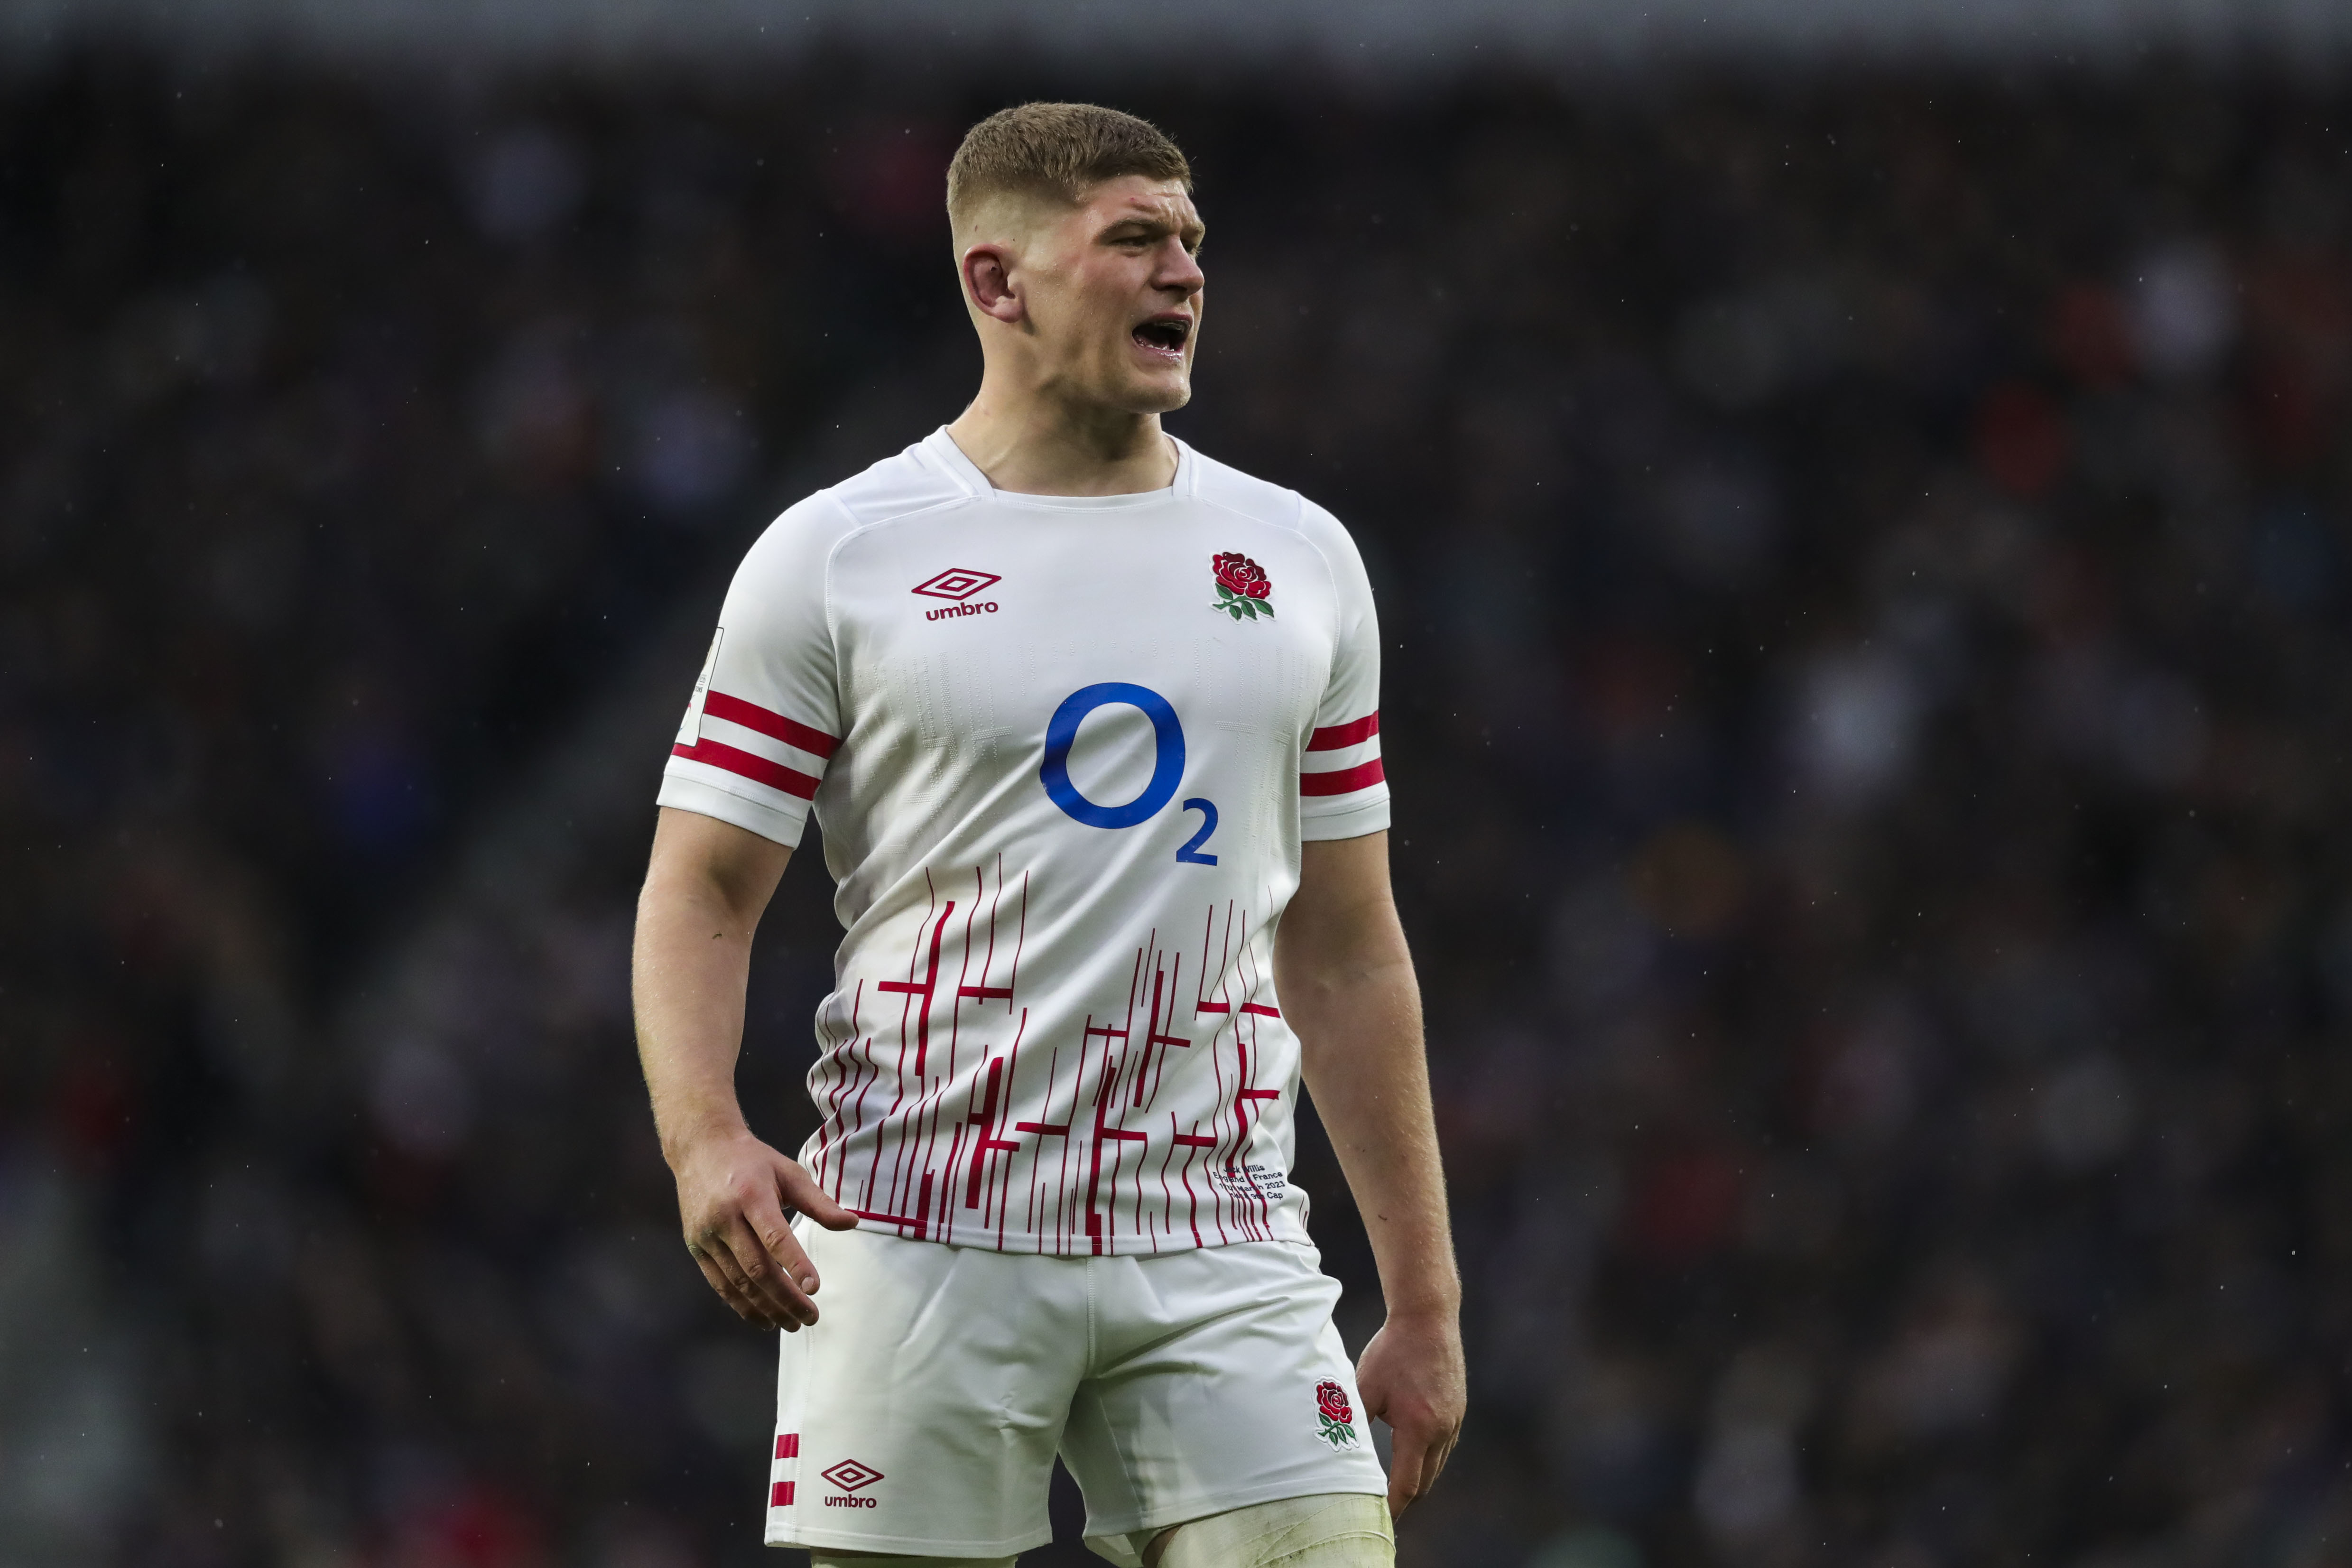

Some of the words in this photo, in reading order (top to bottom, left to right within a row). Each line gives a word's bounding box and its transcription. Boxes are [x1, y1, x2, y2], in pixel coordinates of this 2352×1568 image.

[926, 602, 999, 621] umbro
[1243, 1164, 1265, 1173] Willis
[1213, 1171, 1245, 1182] Engand
[1252, 1172, 1283, 1181] France
[1265, 1181, 1285, 1189] 2023
[1267, 1192, 1283, 1200] Cap
[824, 1494, 877, 1508] umbro
